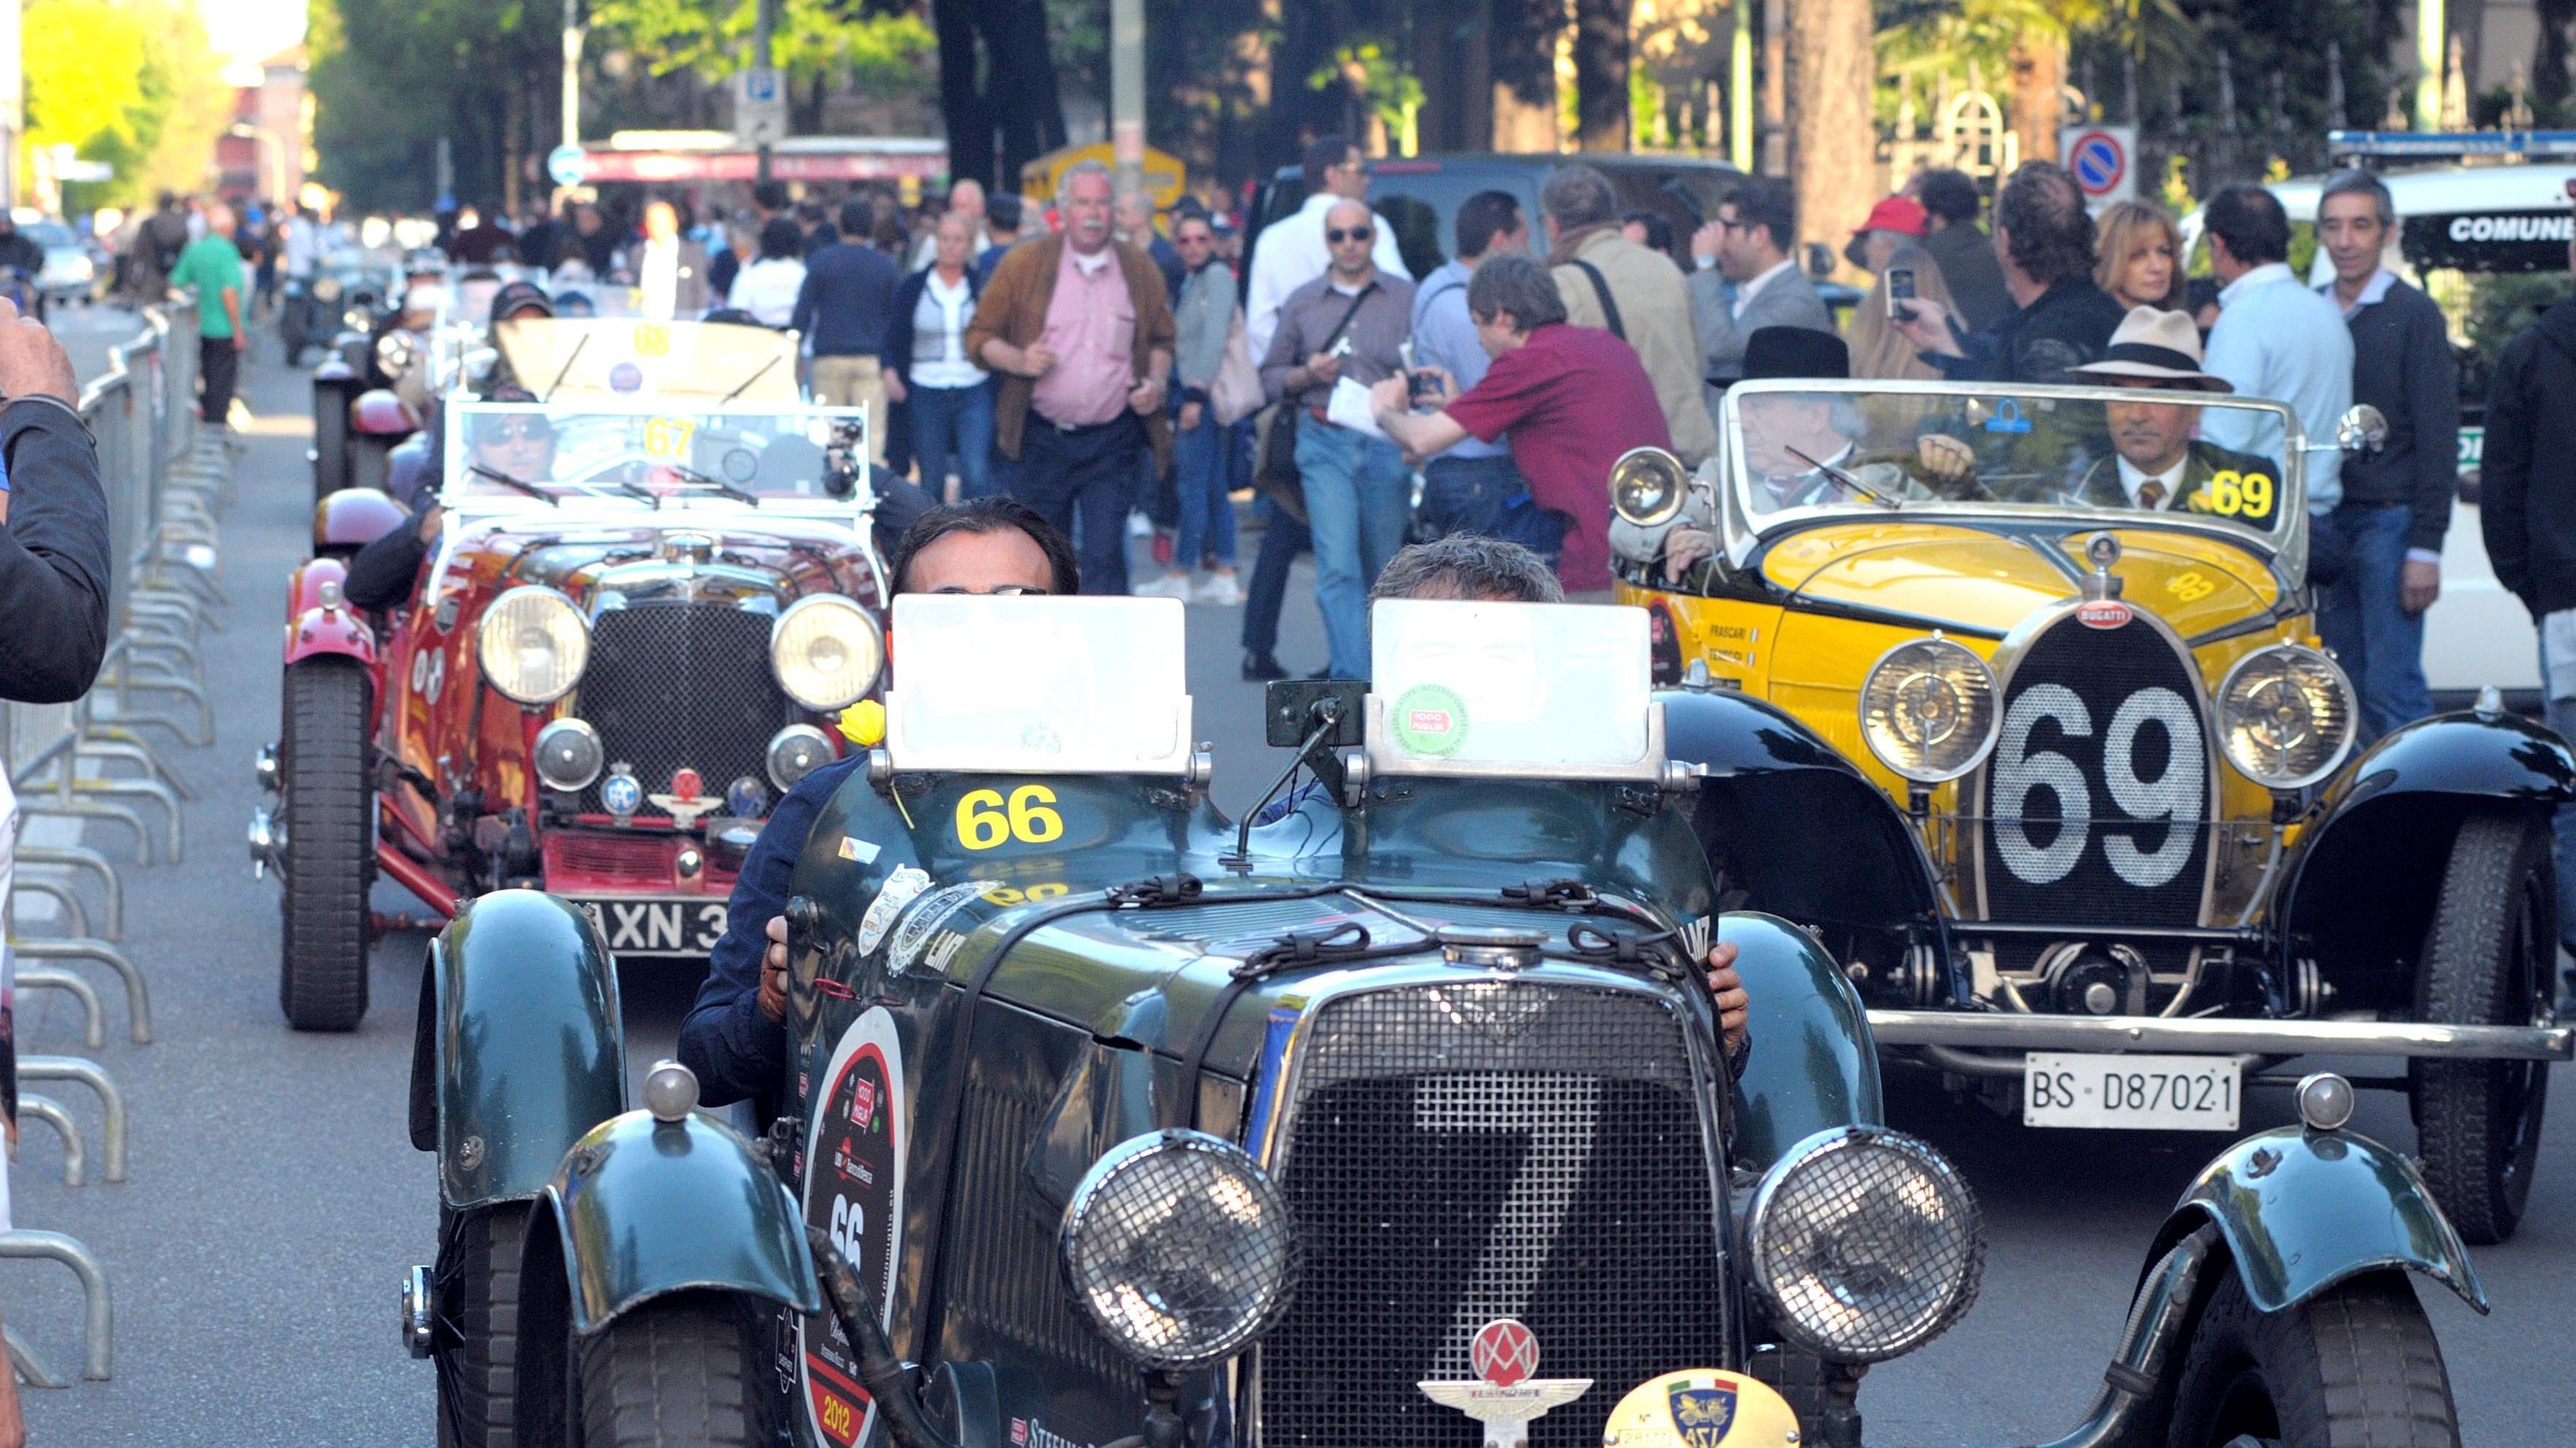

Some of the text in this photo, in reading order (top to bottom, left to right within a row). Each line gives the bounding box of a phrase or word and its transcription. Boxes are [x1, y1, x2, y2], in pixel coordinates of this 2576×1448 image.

[2449, 217, 2575, 242] COMUNE
[645, 417, 695, 457] 67
[2211, 469, 2273, 518] 69
[2081, 610, 2126, 621] BUGATTI
[1415, 713, 1441, 721] 1000
[1992, 684, 2205, 887] 69
[956, 785, 1063, 850] 66
[1679, 915, 1710, 962] LM7
[857, 1086, 871, 1103] 1000
[2033, 1071, 2232, 1112] BS D87021
[830, 1193, 864, 1272] 66
[1415, 1072, 1601, 1381] 7
[824, 1395, 852, 1438] 2012
